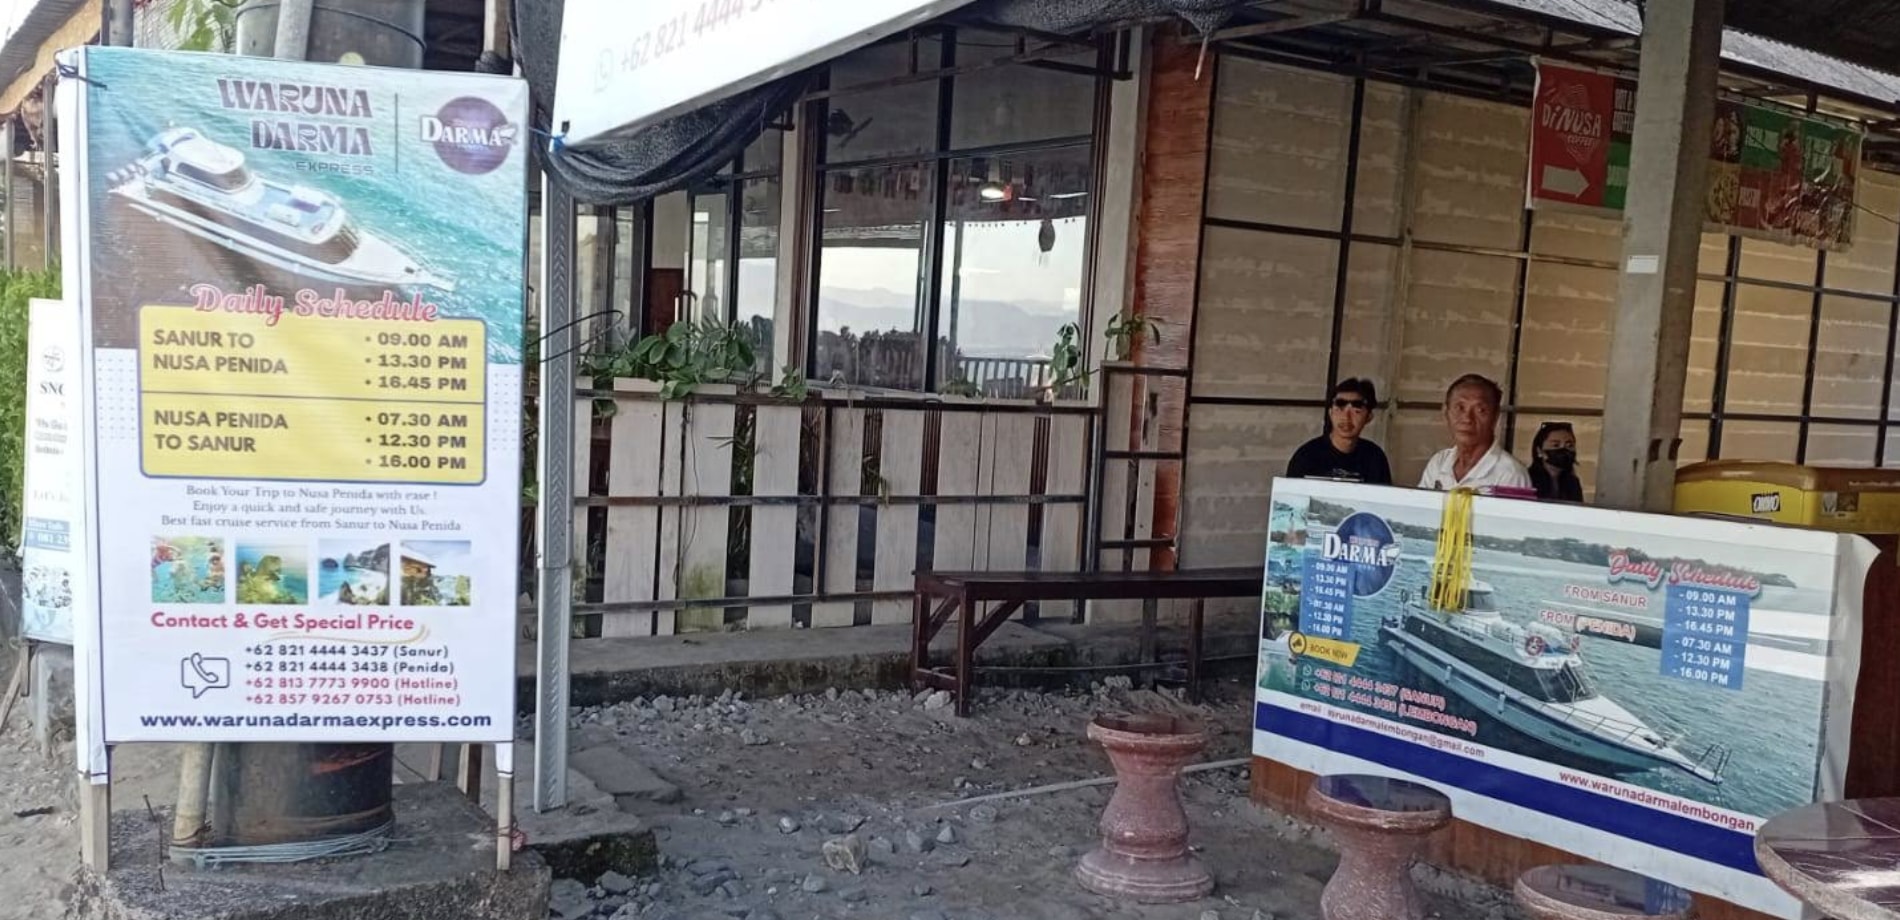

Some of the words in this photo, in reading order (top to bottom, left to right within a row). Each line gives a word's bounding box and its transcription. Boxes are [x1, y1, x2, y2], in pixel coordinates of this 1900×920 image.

[217, 79, 372, 118] WARUNA
[250, 121, 373, 156] DARMA
[422, 116, 502, 147] DARMA
[295, 162, 374, 175] EXPRESS
[190, 282, 284, 326] Daily
[293, 287, 438, 324] Schedule
[153, 329, 223, 349] SANUR
[227, 332, 254, 349] TO
[377, 331, 431, 348] 09.00
[437, 334, 468, 349] AM
[153, 353, 210, 371] NUSA
[215, 355, 288, 374] PENIDA
[378, 354, 431, 369] 13.30
[438, 356, 467, 370] PM
[378, 375, 431, 391] 16.45
[437, 377, 467, 391] PM
[154, 410, 211, 427] NUSA
[215, 411, 288, 429] PENIDA
[377, 412, 431, 427] 07.30
[437, 414, 468, 428] AM
[155, 433, 182, 451] TO
[187, 434, 256, 452] SANUR
[378, 434, 431, 449] 12.30
[437, 435, 467, 449] PM
[378, 455, 431, 470] 16.00
[437, 456, 467, 470] PM
[186, 485, 218, 496] Book
[220, 485, 250, 497] Your
[254, 486, 280, 499] Trip
[283, 488, 295, 497] to
[299, 487, 328, 498] Nusa
[332, 488, 373, 499] Penida
[376, 490, 401, 499] with
[405, 491, 430, 500] ease
[193, 500, 228, 513] Enjoy
[231, 503, 237, 512] a
[241, 502, 275, 514] quick
[278, 503, 300, 513] and
[304, 503, 328, 513] safe
[330, 505, 379, 516] journey
[380, 505, 406, 515] with
[161, 515, 186, 526] Best
[190, 515, 211, 526] fast
[215, 518, 252, 527] cruise
[255, 519, 297, 528] service
[301, 519, 331, 528] from
[335, 519, 369, 529] Sanur
[373, 520, 385, 530] to
[388, 520, 418, 530] Nusa
[421, 520, 461, 531] Penida
[1323, 533, 1388, 567] DARMA
[1610, 551, 1663, 581] Daily
[1668, 562, 1760, 591] Schedule
[1564, 585, 1599, 601] FROM
[1600, 592, 1648, 607] SANUR
[1686, 591, 1715, 603] 09.00
[1717, 593, 1737, 606] AM
[1540, 610, 1576, 624] FROM
[1685, 606, 1714, 619] 13.30
[1716, 609, 1735, 622] PM
[151, 612, 227, 629] Contact
[233, 613, 248, 629] &
[253, 613, 288, 629] Get
[294, 613, 362, 633] Special
[367, 614, 414, 630] Price
[1715, 624, 1734, 636] PM
[245, 645, 274, 656] +62
[278, 645, 304, 656] 821
[309, 645, 346, 656] 4444
[351, 645, 388, 656] 3437
[393, 645, 449, 658] (Sanur)
[1681, 637, 1711, 651] 07.30
[1713, 642, 1732, 655] AM
[245, 661, 274, 672] +62
[278, 661, 304, 672] 821
[309, 661, 346, 672] 4444
[351, 662, 388, 672] 3438
[393, 661, 454, 674] (Penida)
[1681, 652, 1709, 666] 12.30
[1712, 657, 1730, 670] PM
[245, 678, 274, 689] +62
[278, 678, 303, 689] 813
[309, 678, 346, 689] 7773
[351, 678, 390, 689] 9900
[395, 677, 458, 691] (Hotline)
[1710, 672, 1728, 685] PM
[245, 694, 274, 705] +62
[278, 694, 307, 705] 857
[312, 694, 350, 705] 9267
[355, 694, 393, 705] 0753
[397, 694, 461, 708] (Hotline)
[140, 713, 492, 730] www.warunadarmaexpress.com
[1559, 770, 1759, 832] www.warunadarmalembongan.
